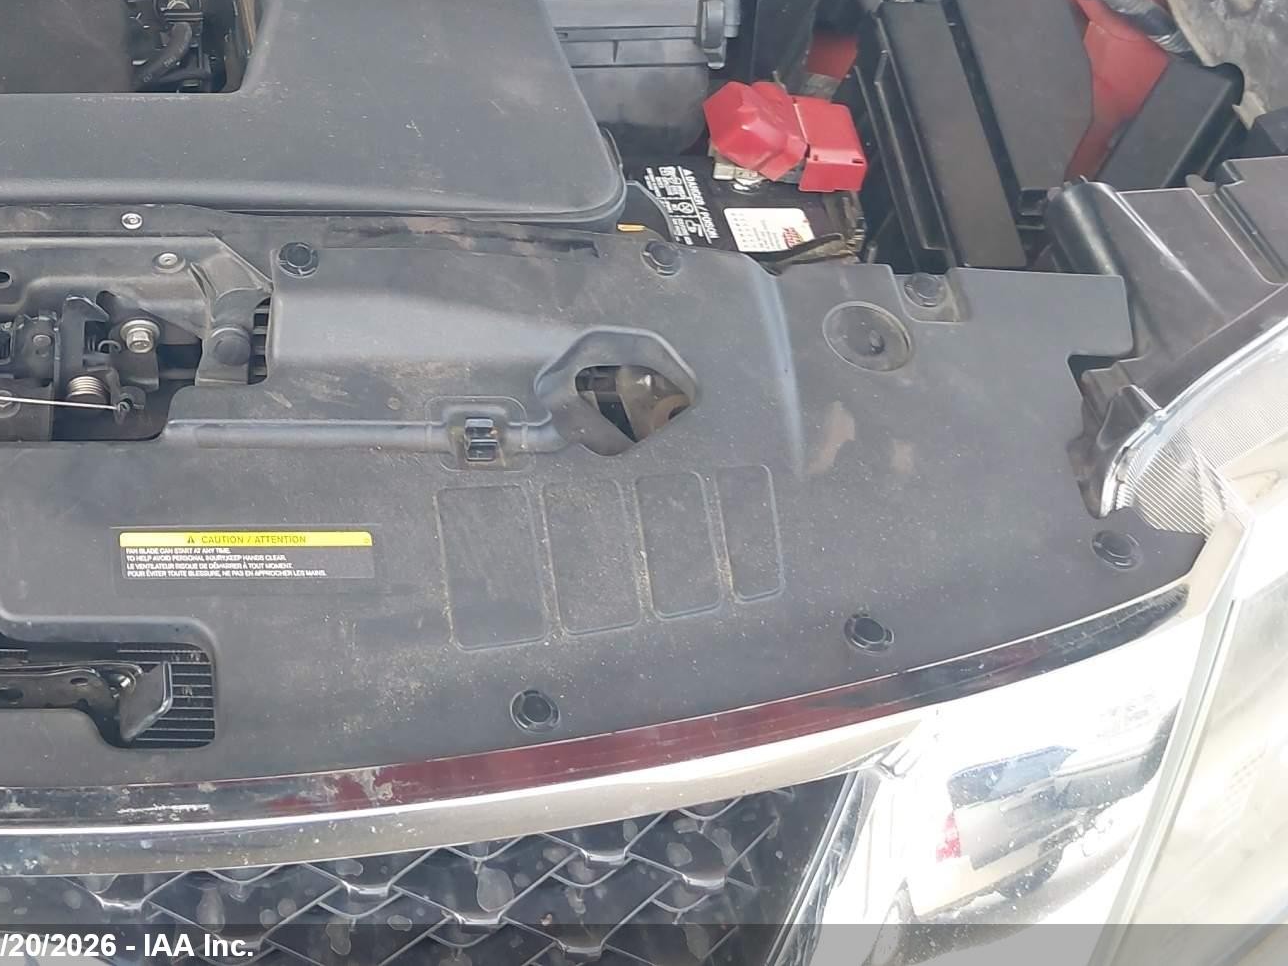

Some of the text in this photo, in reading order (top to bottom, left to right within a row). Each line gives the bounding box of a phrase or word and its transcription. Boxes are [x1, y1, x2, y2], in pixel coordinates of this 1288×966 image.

[684, 175, 706, 206] DANGER
[698, 211, 720, 239] POISON
[201, 535, 244, 544] CAUTION
[254, 535, 306, 544] ATTENTION
